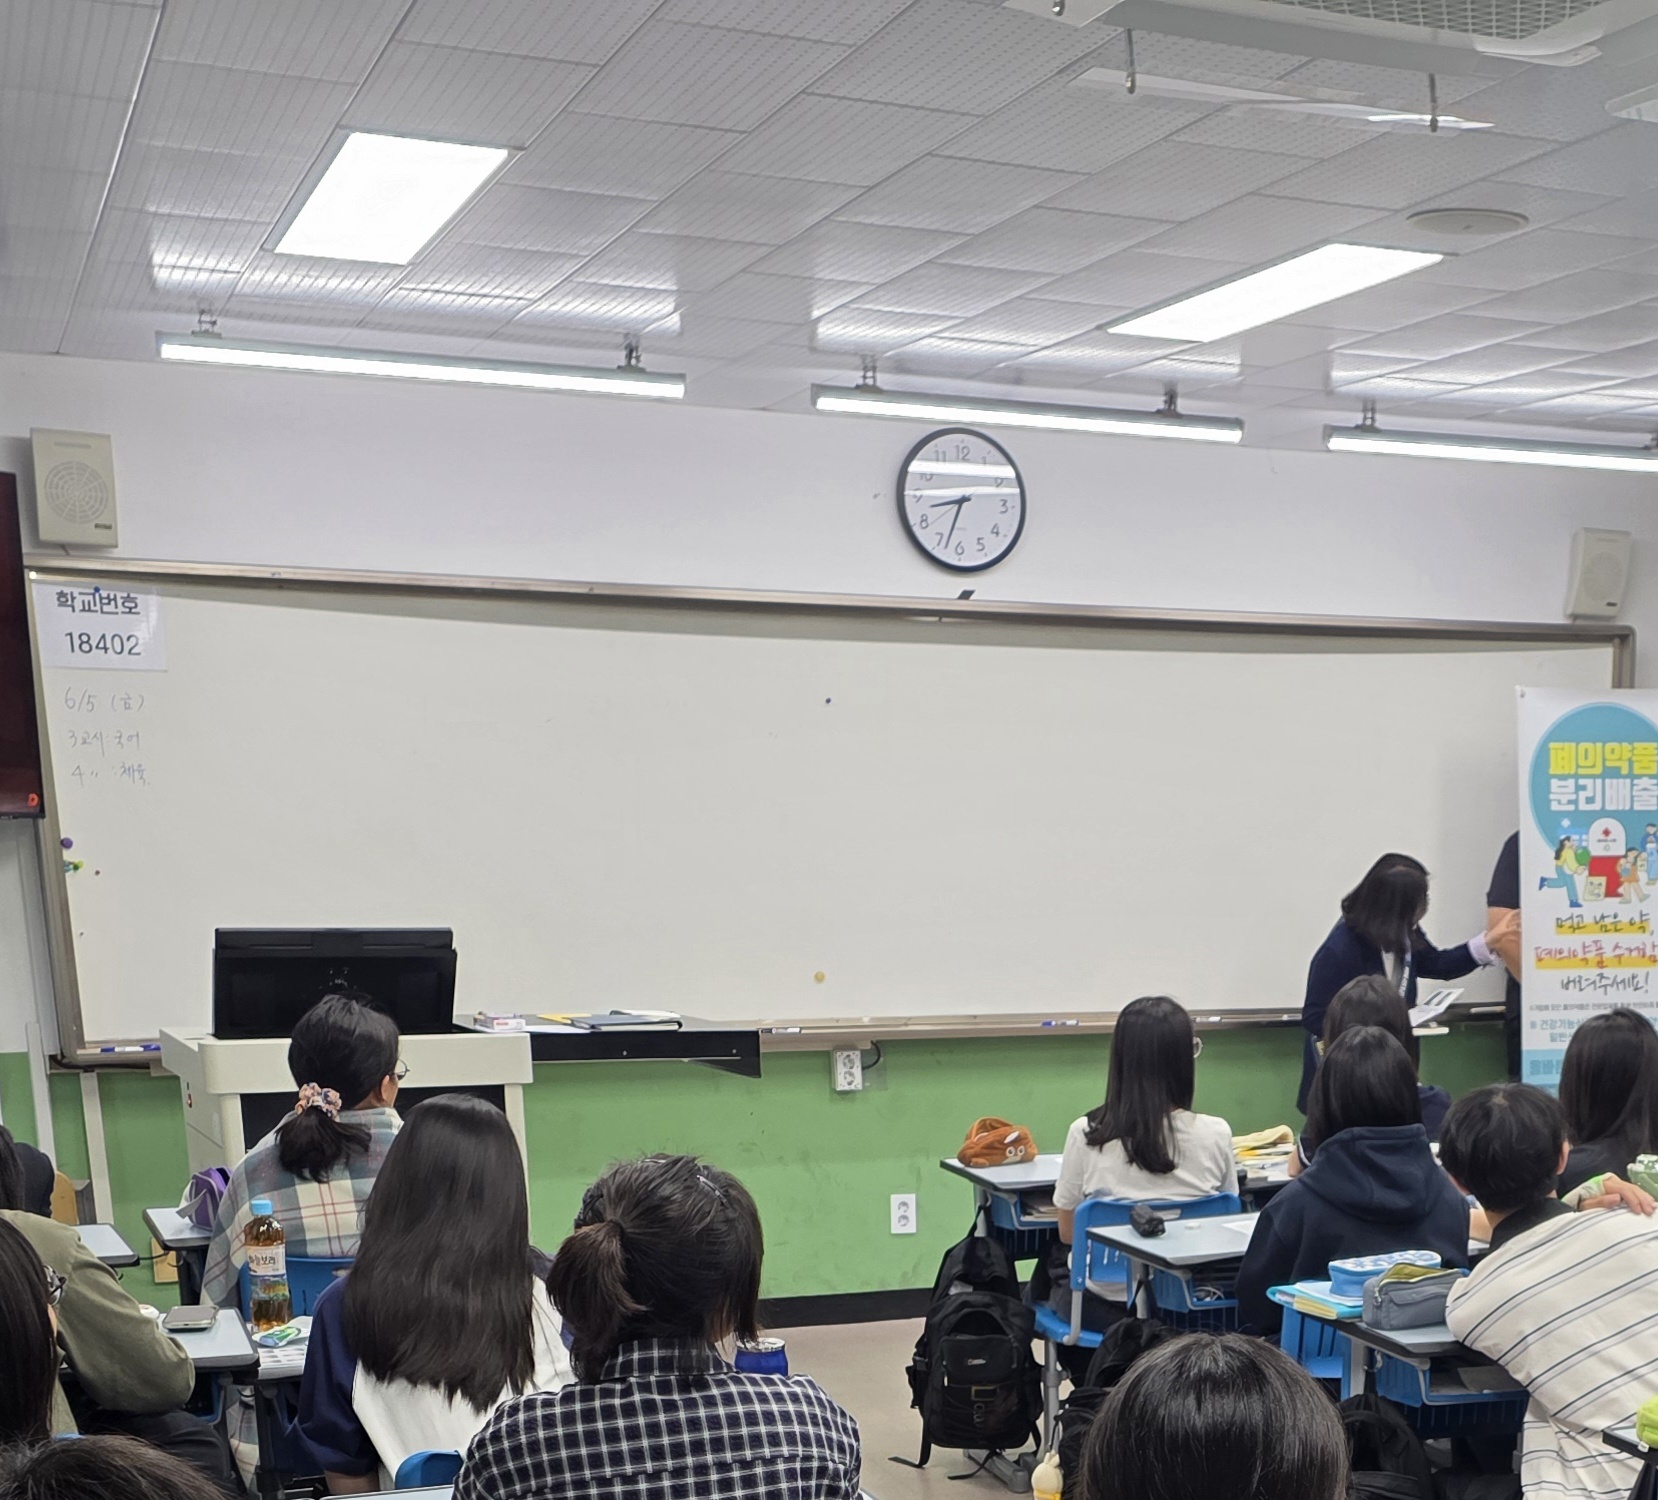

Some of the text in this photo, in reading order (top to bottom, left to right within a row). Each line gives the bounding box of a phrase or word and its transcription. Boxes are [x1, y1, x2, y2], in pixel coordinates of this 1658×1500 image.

[954, 444, 970, 461] 12
[999, 499, 1009, 514] 3
[920, 513, 929, 530] 8
[991, 523, 1000, 537] 4
[955, 541, 965, 556] 6
[976, 537, 985, 552] 5
[56, 590, 141, 615] 학교번호
[64, 631, 142, 656] 18402
[1549, 742, 1658, 775] 폐의약품
[1549, 777, 1658, 811] 분리배출
[1556, 912, 1587, 934] 먹고
[1594, 911, 1623, 934] 남은
[1534, 940, 1608, 969] 폐의약품
[1561, 971, 1650, 996] 버려주세요!
